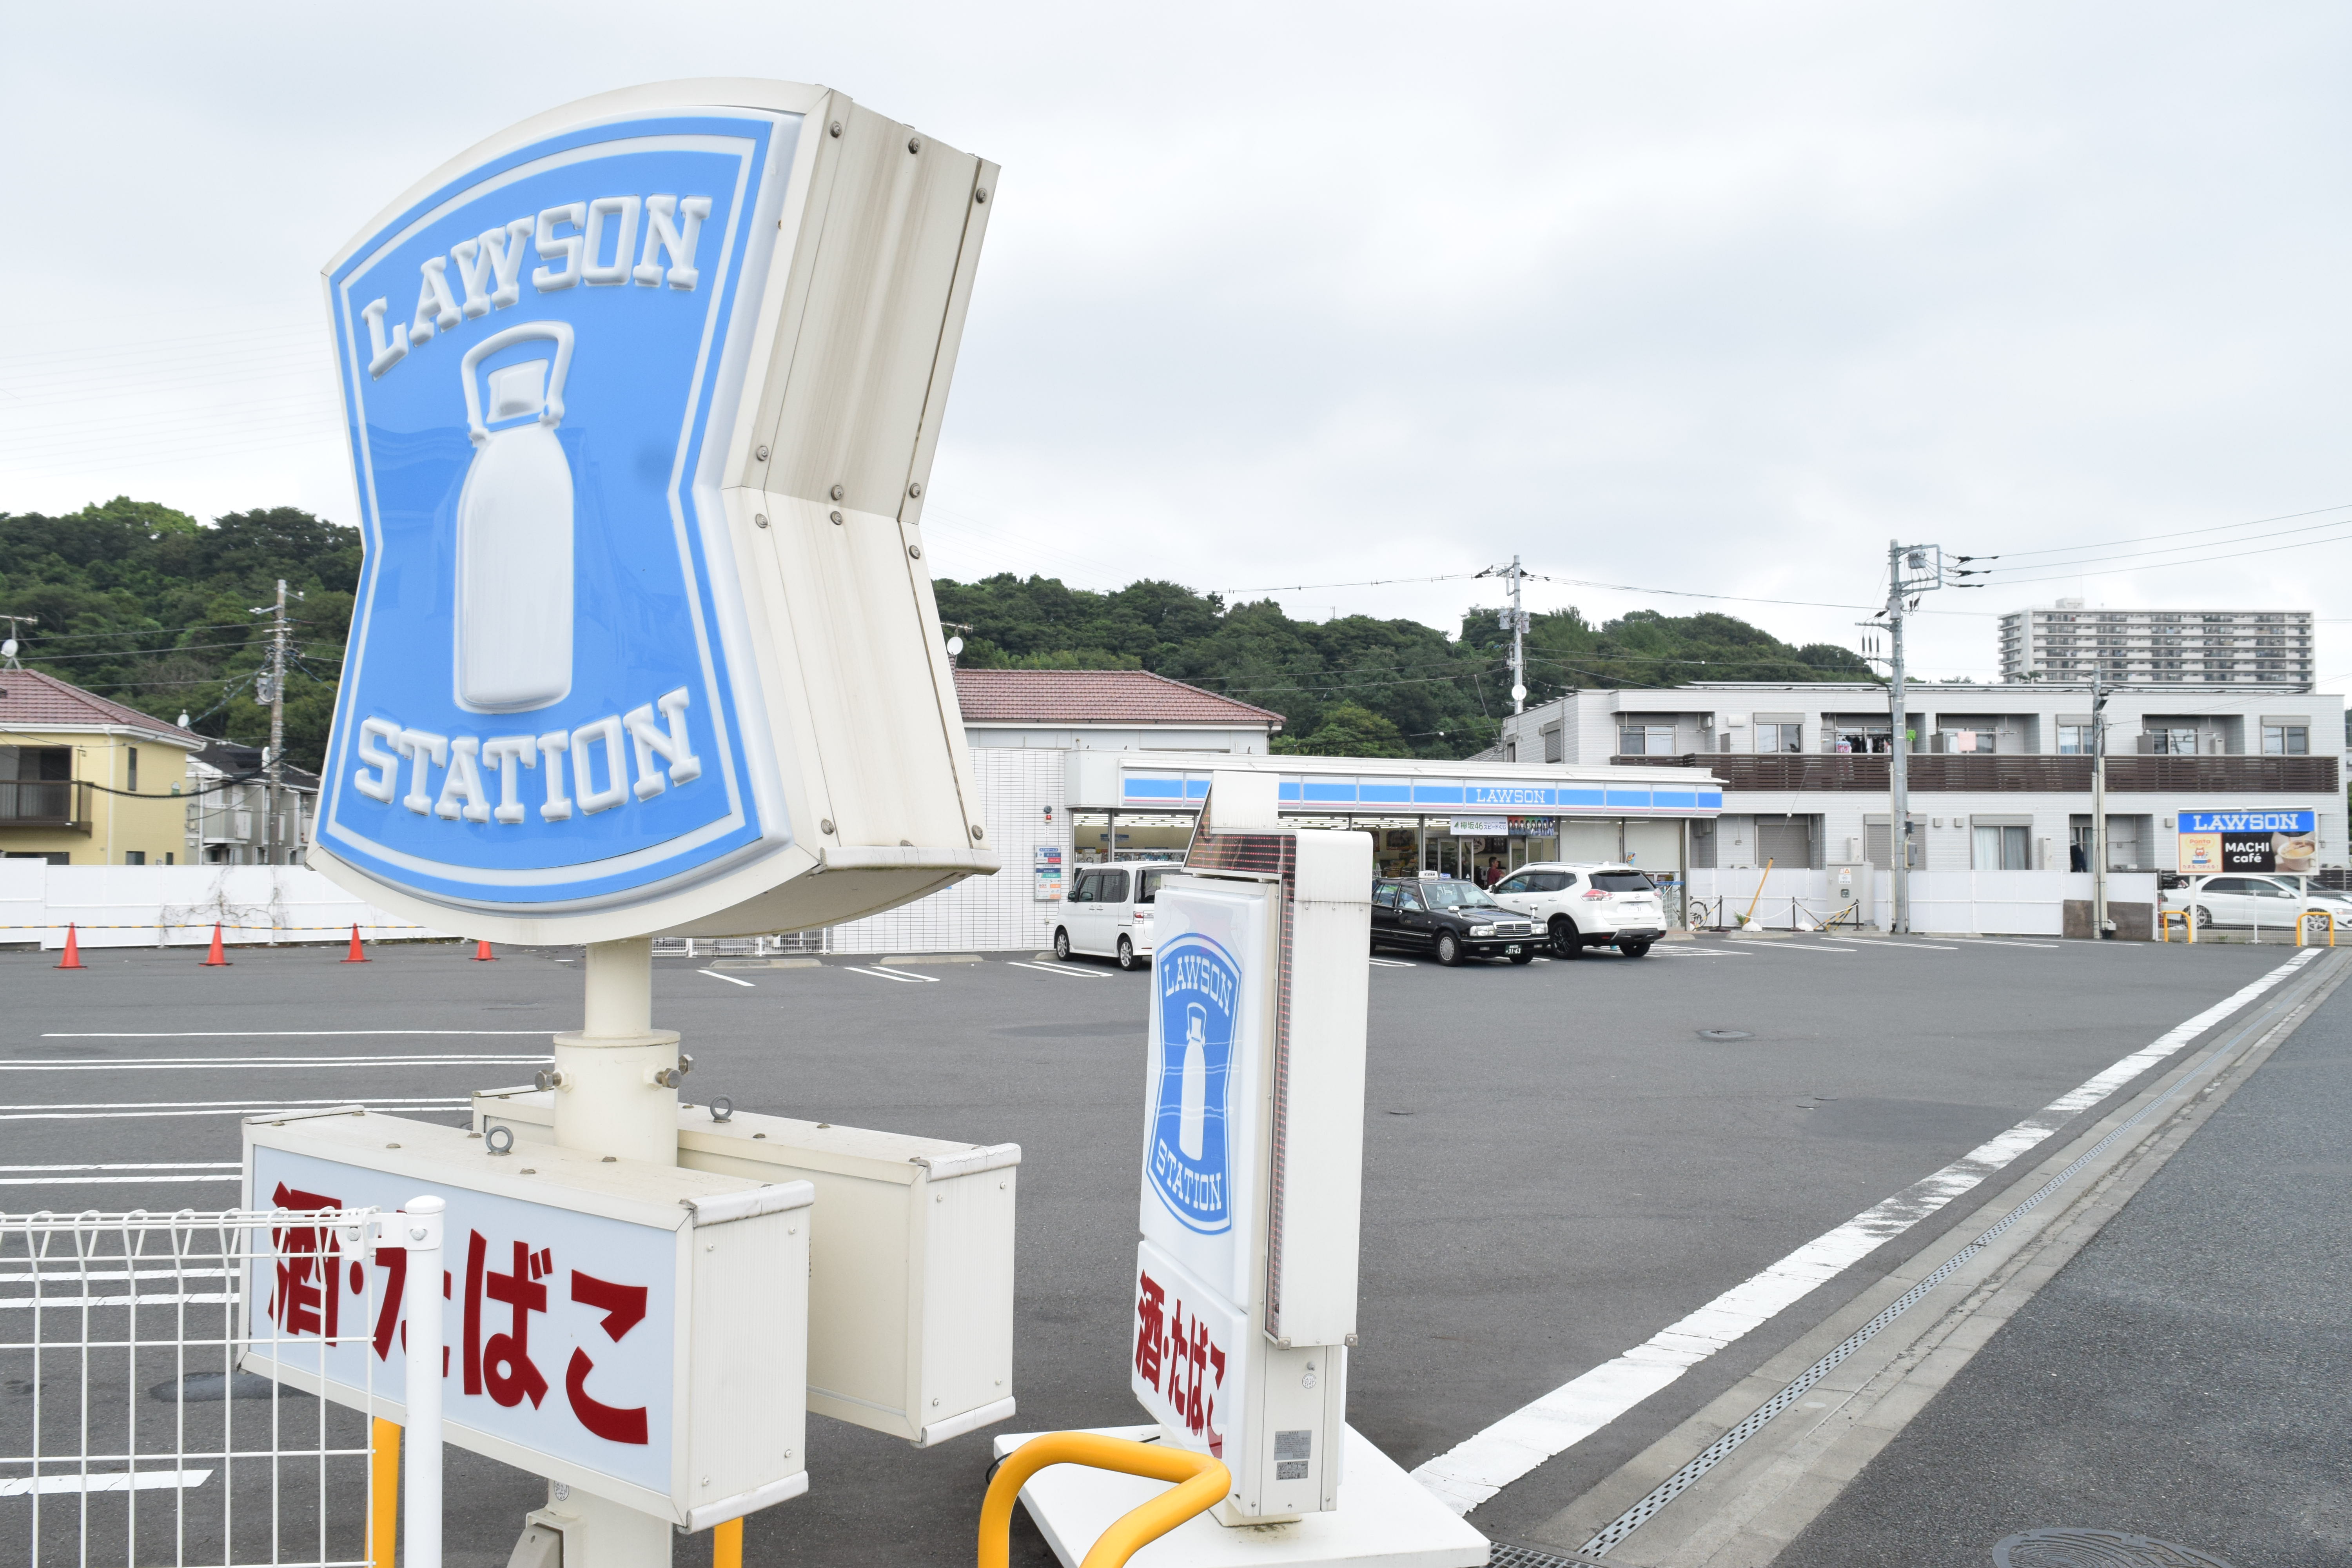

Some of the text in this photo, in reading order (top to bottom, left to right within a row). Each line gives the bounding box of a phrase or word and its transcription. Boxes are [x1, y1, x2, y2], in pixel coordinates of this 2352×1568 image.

[360, 192, 712, 381] LAWSON
[354, 686, 702, 825] STATION
[1476, 789, 1545, 803] LAWSON
[1461, 822, 1483, 830] 欅坂46
[2194, 814, 2298, 830] LAWSON
[2225, 842, 2269, 852] MACHI
[2233, 853, 2262, 863] café
[1165, 955, 1232, 1017] LAWSON
[1156, 1138, 1221, 1212] STATION
[1136, 1269, 1225, 1459] 酒・たばこ
